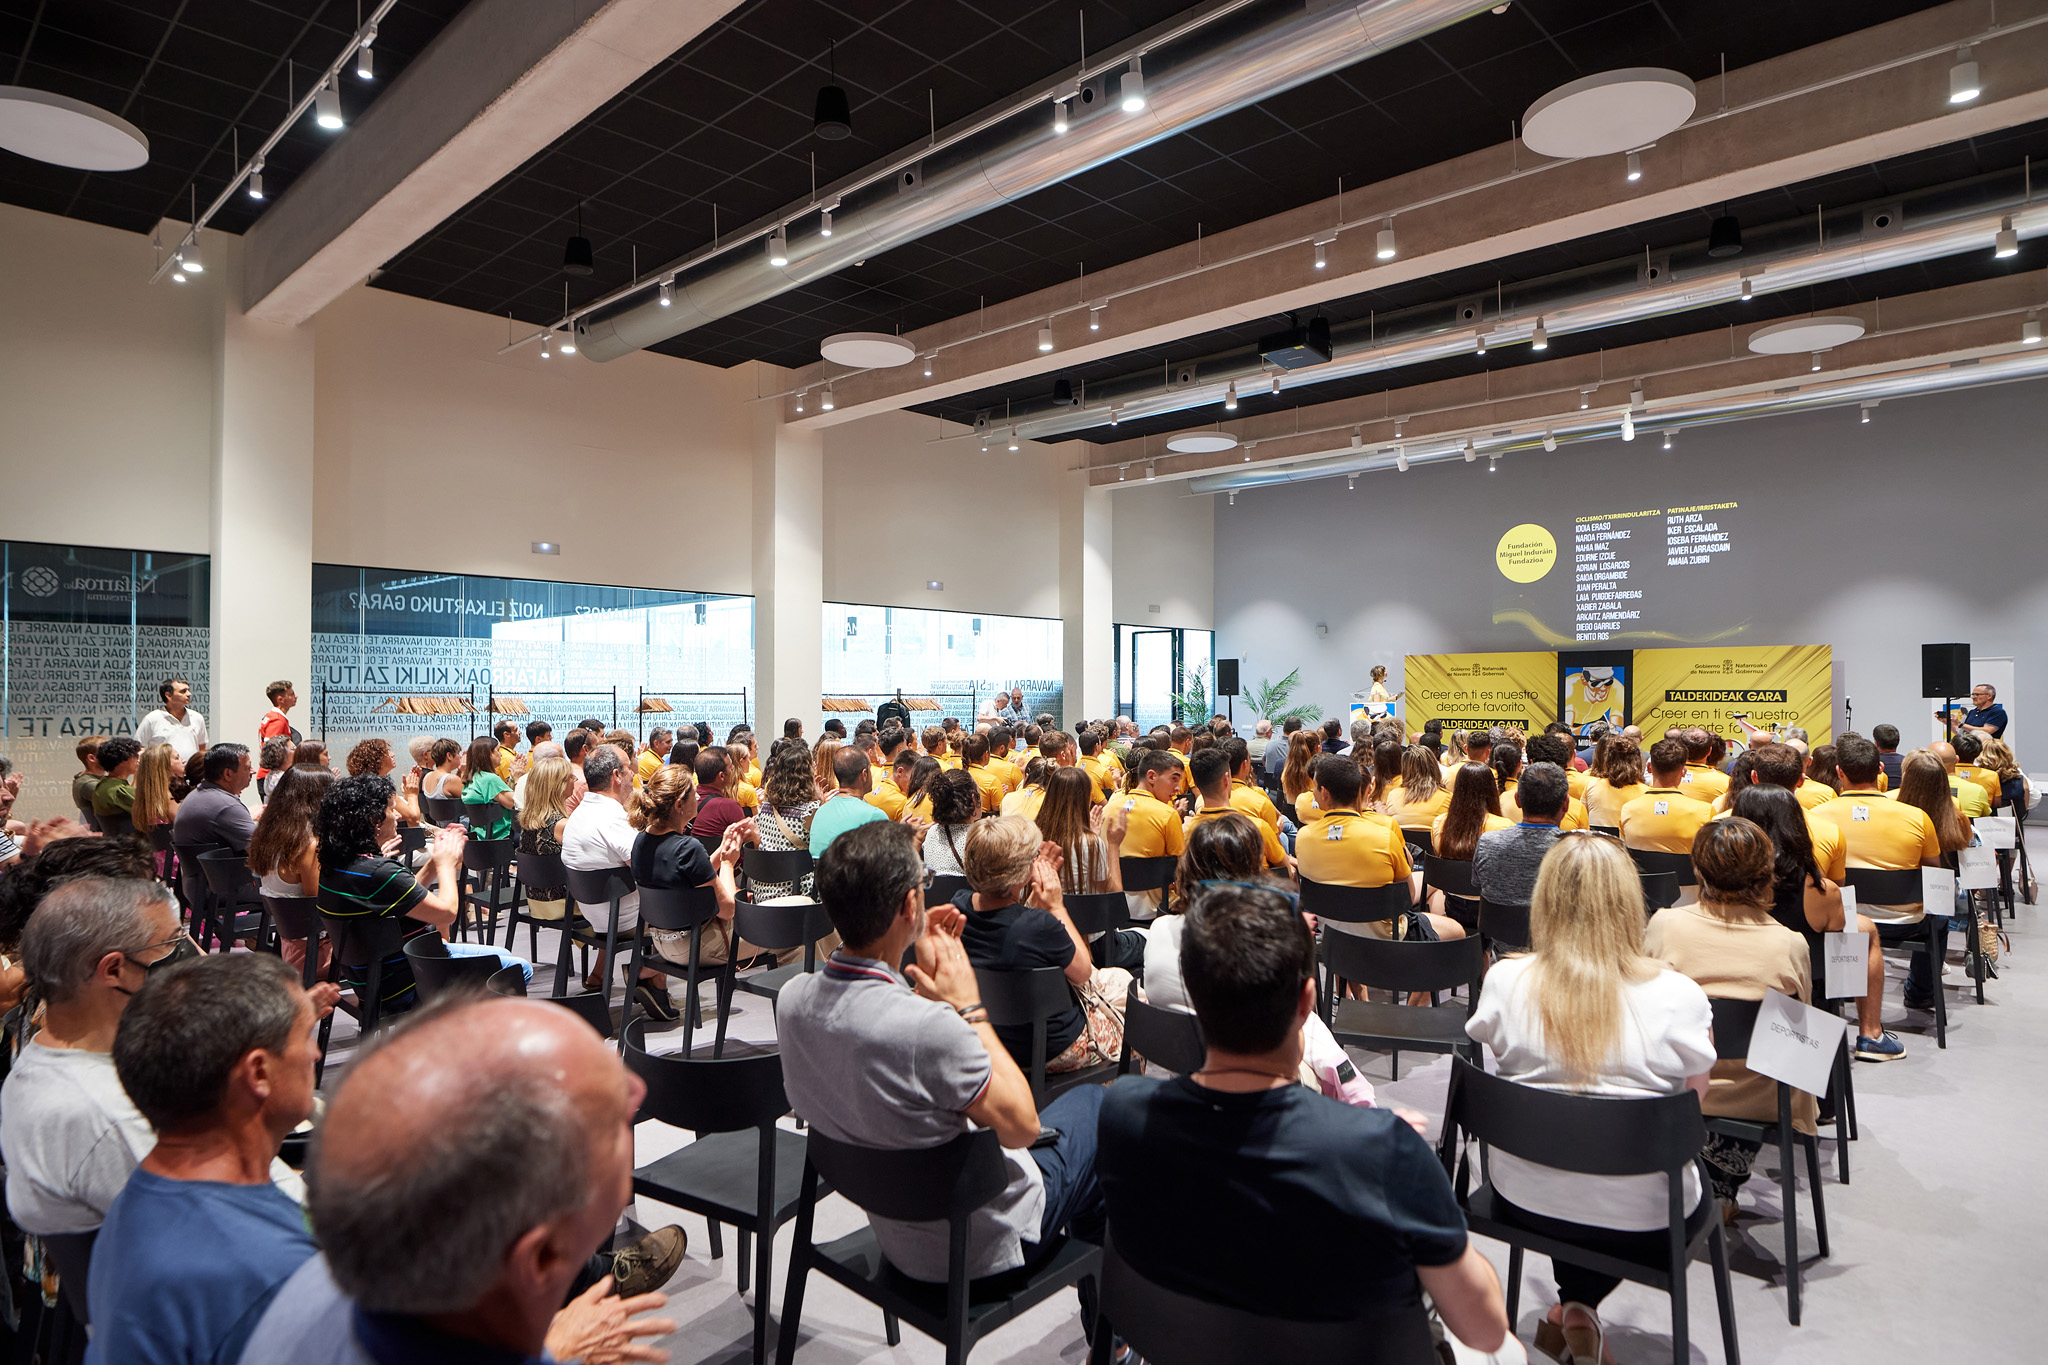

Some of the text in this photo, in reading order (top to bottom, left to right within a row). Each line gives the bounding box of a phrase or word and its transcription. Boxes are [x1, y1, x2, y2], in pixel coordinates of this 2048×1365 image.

[1667, 502, 1738, 514] PATINAJE/IRRISTAKETA
[1575, 509, 1661, 523] CICLISMO/TXIRRINDULARITZA
[1667, 514, 1703, 525] RUTH ARZA
[1591, 522, 1611, 531] ERASO
[1667, 523, 1718, 535] IKER ESCALADA
[1575, 530, 1631, 543] NAROA FERNÁNDEZ
[1667, 532, 1729, 545] IOSEBA FERNÁNDEZ
[1507, 541, 1543, 549] Fundación
[1575, 542, 1610, 553] NAHIA IMAZ
[1667, 543, 1731, 556] JAVIER LARRASOAIN
[1500, 548, 1553, 559] Miguel Induráin
[1575, 551, 1616, 563] EDURNE IZCUE
[1509, 557, 1544, 565] Fundazioa
[1667, 555, 1710, 566] AMAIA ZUBIRI
[1575, 561, 1631, 572] ADRIAN LOSARCOS
[1594, 571, 1628, 581] ORGAMBIDE
[1576, 582, 1617, 592] JUAN PERALTA
[1576, 590, 1643, 602] LAIA PUIGDEFABREGAS
[1576, 602, 1622, 612] XABIER ZABALA
[1576, 610, 1641, 621] ARKAITZ ARMENDÁRIZ
[1576, 622, 1621, 631] DIEGO GARRUES
[1576, 632, 1609, 641] BENITO ROS
[1421, 690, 1451, 700] Creer
[1471, 690, 1477, 699] ti
[1480, 692, 1493, 700] es
[1496, 690, 1538, 700] nuestro
[1669, 691, 1782, 701] TALDEKIDEAK GARA
[1436, 702, 1525, 713] deporte favorito
[1650, 707, 1687, 719] Creer
[1691, 710, 1709, 719] en
[1714, 708, 1721, 719] ti
[1747, 709, 1799, 720] nuestro
[1497, 721, 1525, 730] GARA
[1729, 722, 1783, 734] faorito
[1831, 955, 1859, 963] DEPORTISTAS
[1770, 1021, 1819, 1050] DEPORTISTAS
